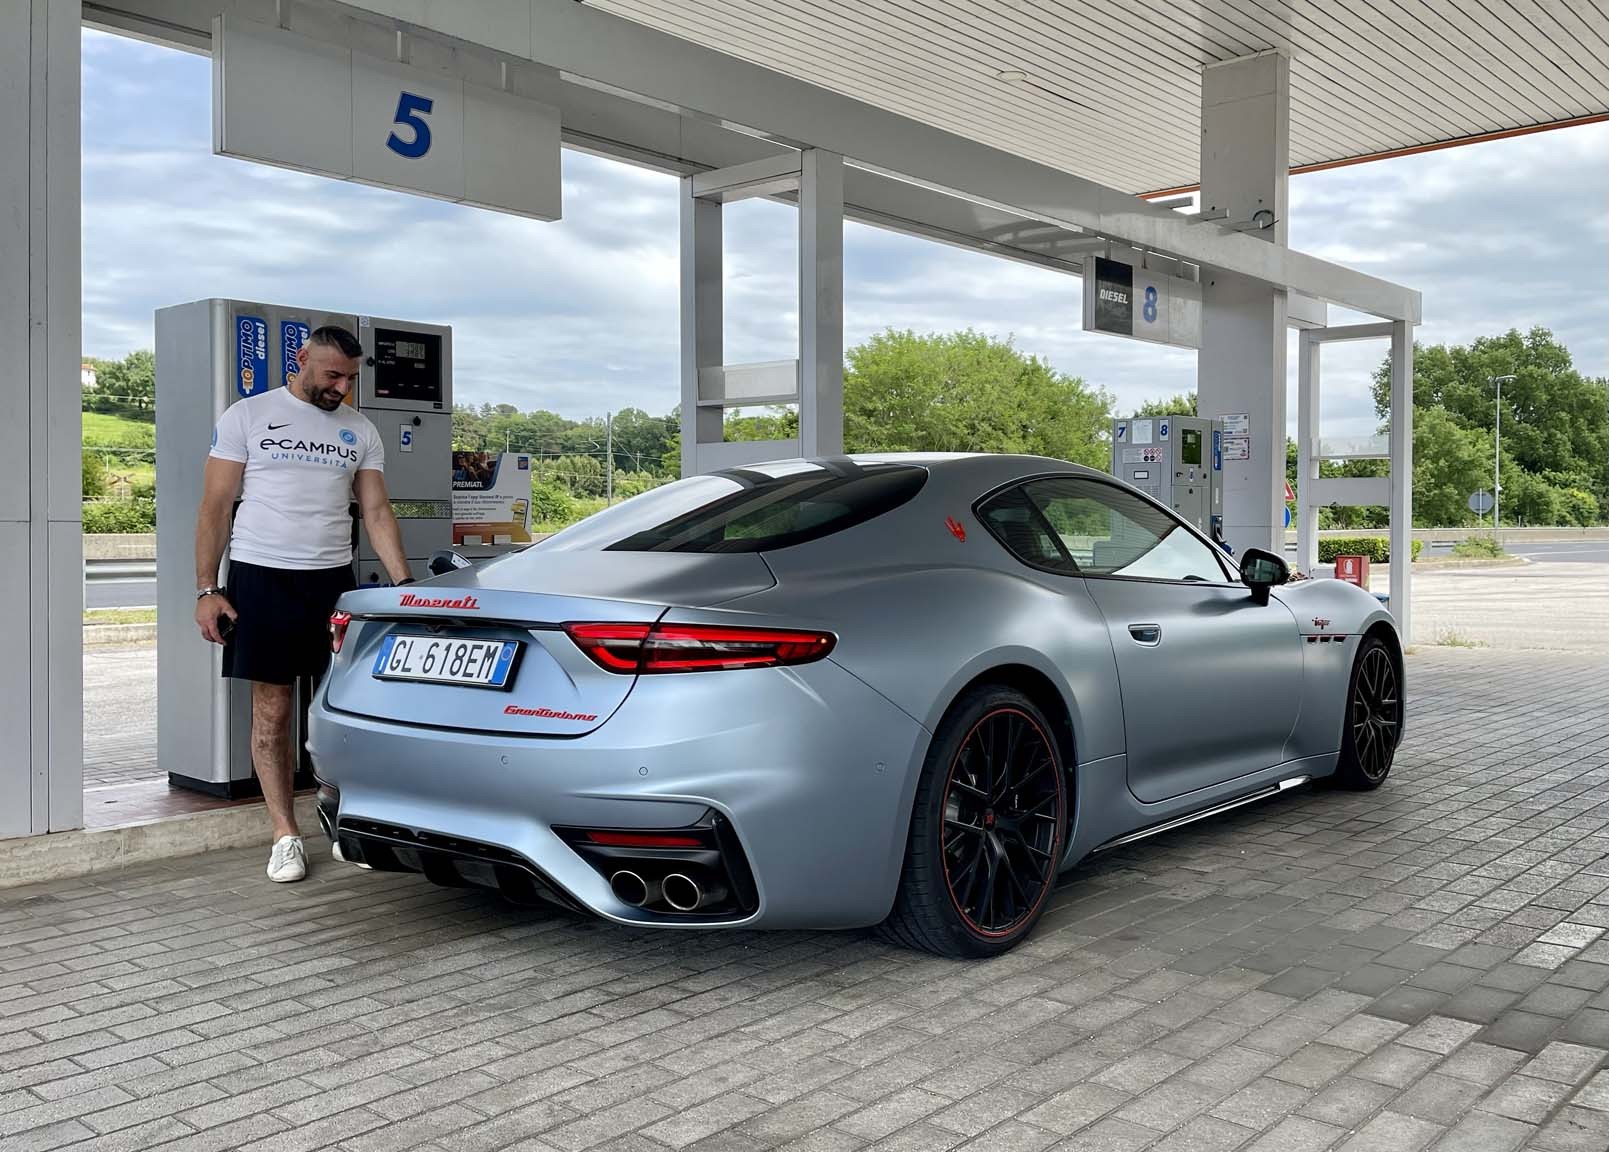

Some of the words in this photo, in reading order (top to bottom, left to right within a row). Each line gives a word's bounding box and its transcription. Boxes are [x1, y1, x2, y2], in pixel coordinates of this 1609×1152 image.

[386, 91, 434, 159] 5
[1099, 288, 1129, 305] DIESEL
[1143, 286, 1158, 324] 8
[255, 322, 266, 360] diesel
[240, 319, 254, 382] OPTIMO
[401, 431, 412, 445] 5
[1117, 426, 1127, 438] 7
[1160, 424, 1169, 436] 8
[271, 452, 348, 469] UNIVERSITÀ
[399, 594, 481, 609] Maserati
[389, 639, 414, 673] GL
[422, 641, 500, 680] 618EM
[503, 704, 598, 722] GranTurismo
